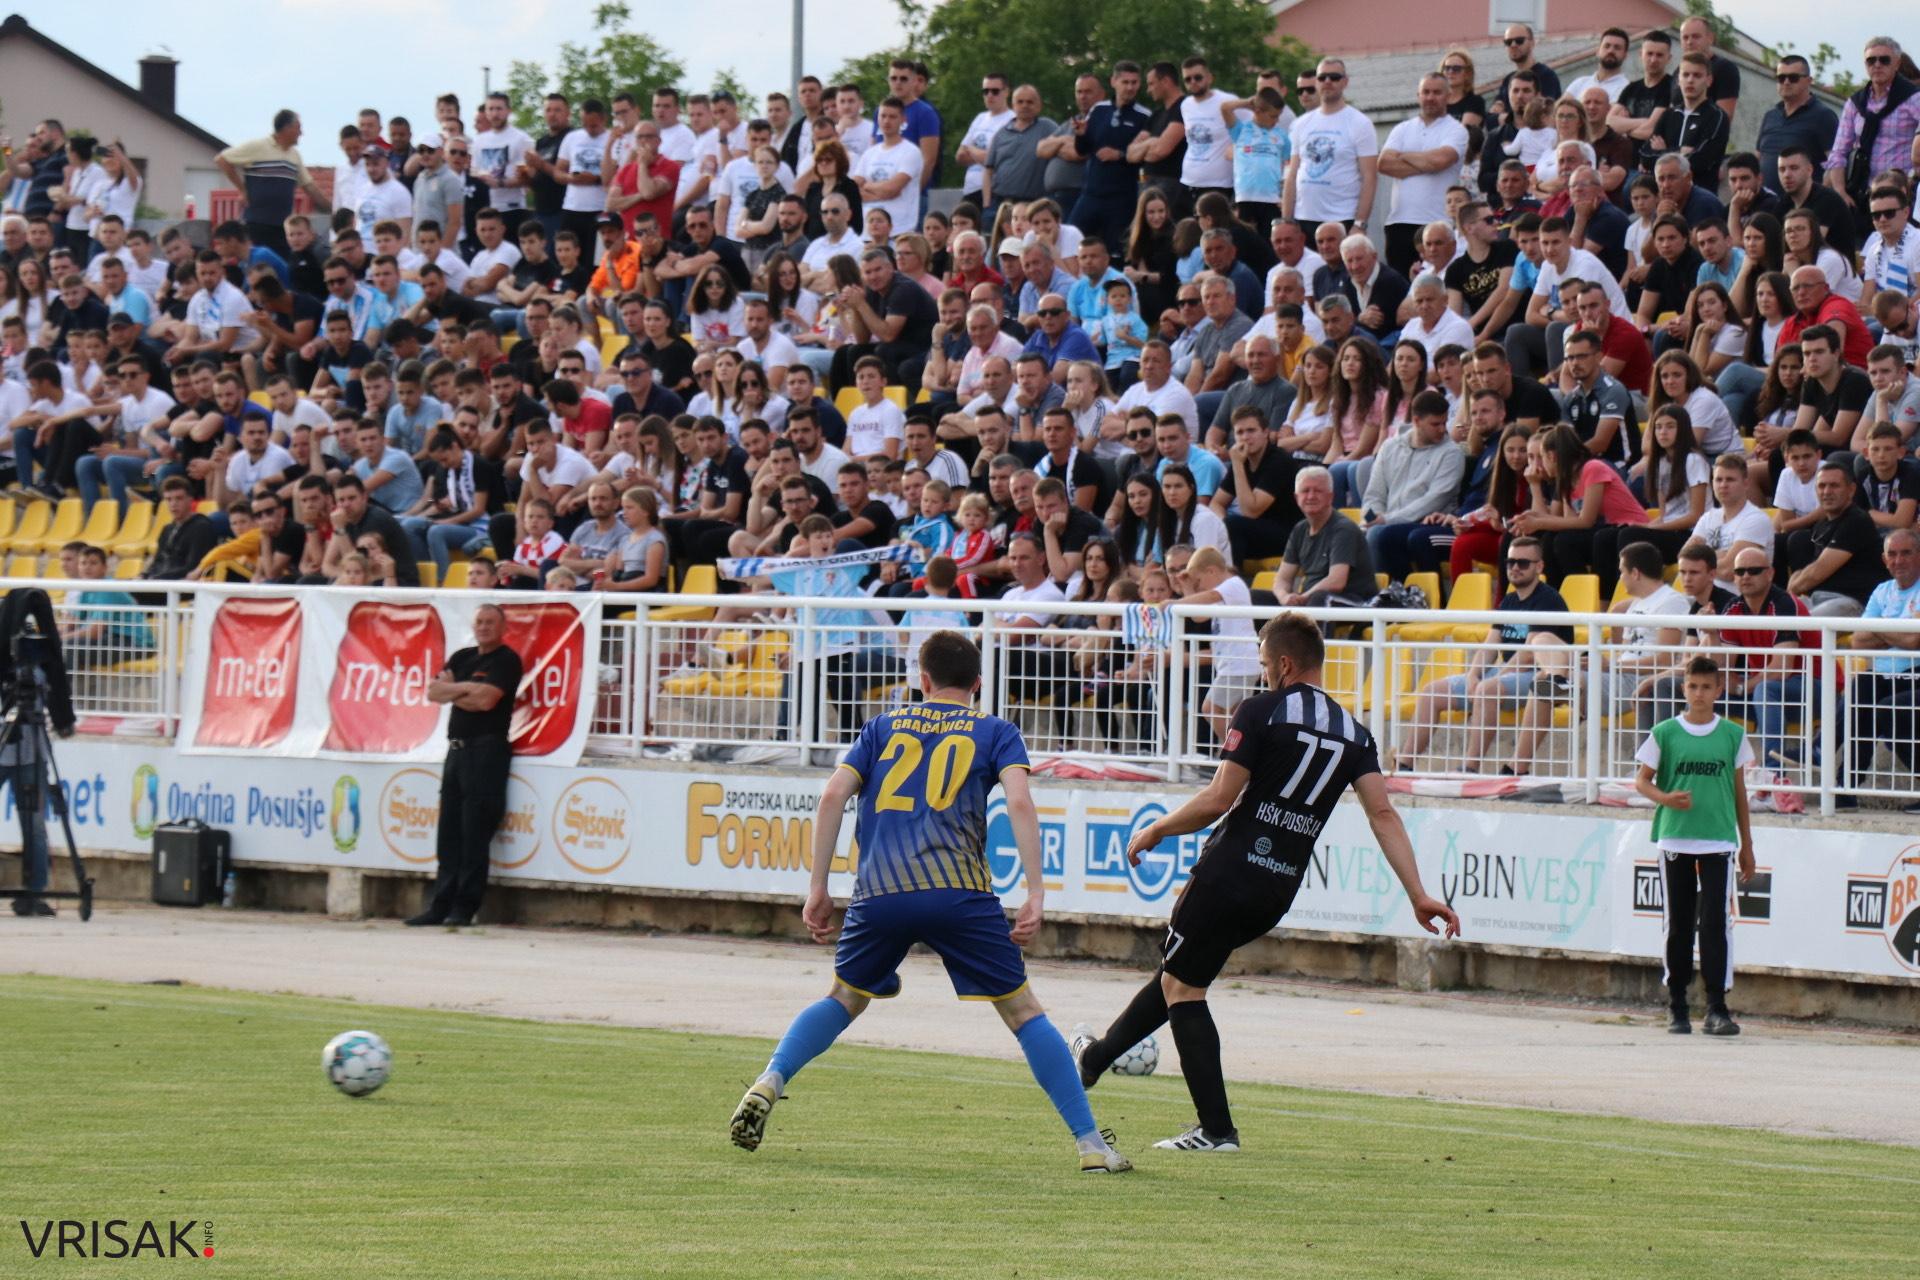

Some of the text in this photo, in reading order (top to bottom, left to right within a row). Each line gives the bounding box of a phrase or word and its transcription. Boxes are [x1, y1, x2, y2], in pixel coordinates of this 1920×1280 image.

[216, 641, 291, 698] m:tel
[342, 649, 434, 708] m:tel
[891, 718, 975, 734] GRAČANICA
[911, 707, 988, 721] BRATSTVO
[875, 732, 976, 814] 20
[1279, 730, 1345, 807] 77
[247, 786, 325, 839] Posušje
[726, 791, 782, 811] SPORTSKA
[1255, 801, 1283, 826] HŠK
[1088, 807, 1206, 896] LAGE
[1247, 852, 1298, 877] weltplast
[1462, 853, 1605, 907] BINVEST
[1850, 885, 1883, 924] KTM
